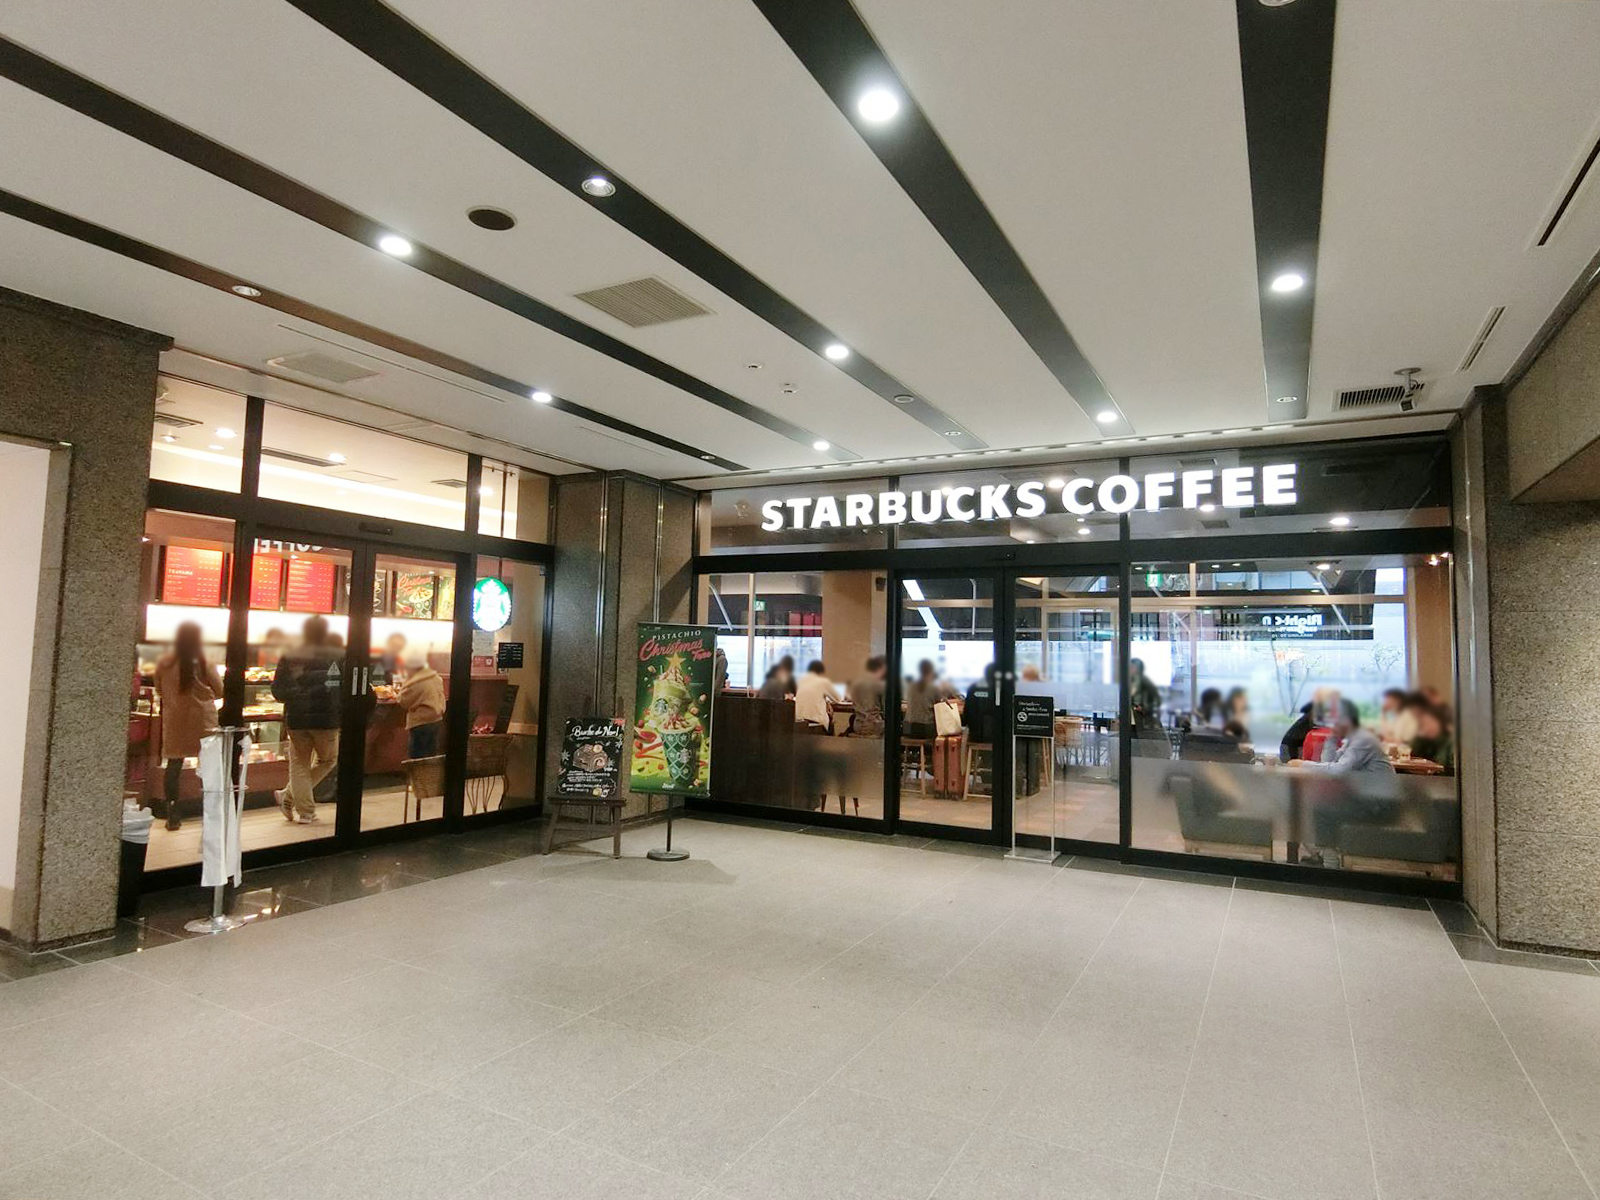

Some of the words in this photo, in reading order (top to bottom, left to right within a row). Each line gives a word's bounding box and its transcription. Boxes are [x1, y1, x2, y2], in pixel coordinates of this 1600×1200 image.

[761, 481, 1046, 532] STARBUCKS
[1061, 463, 1297, 515] COFFEE
[652, 629, 702, 641] PISTACHIO
[640, 639, 703, 661] Christmas
